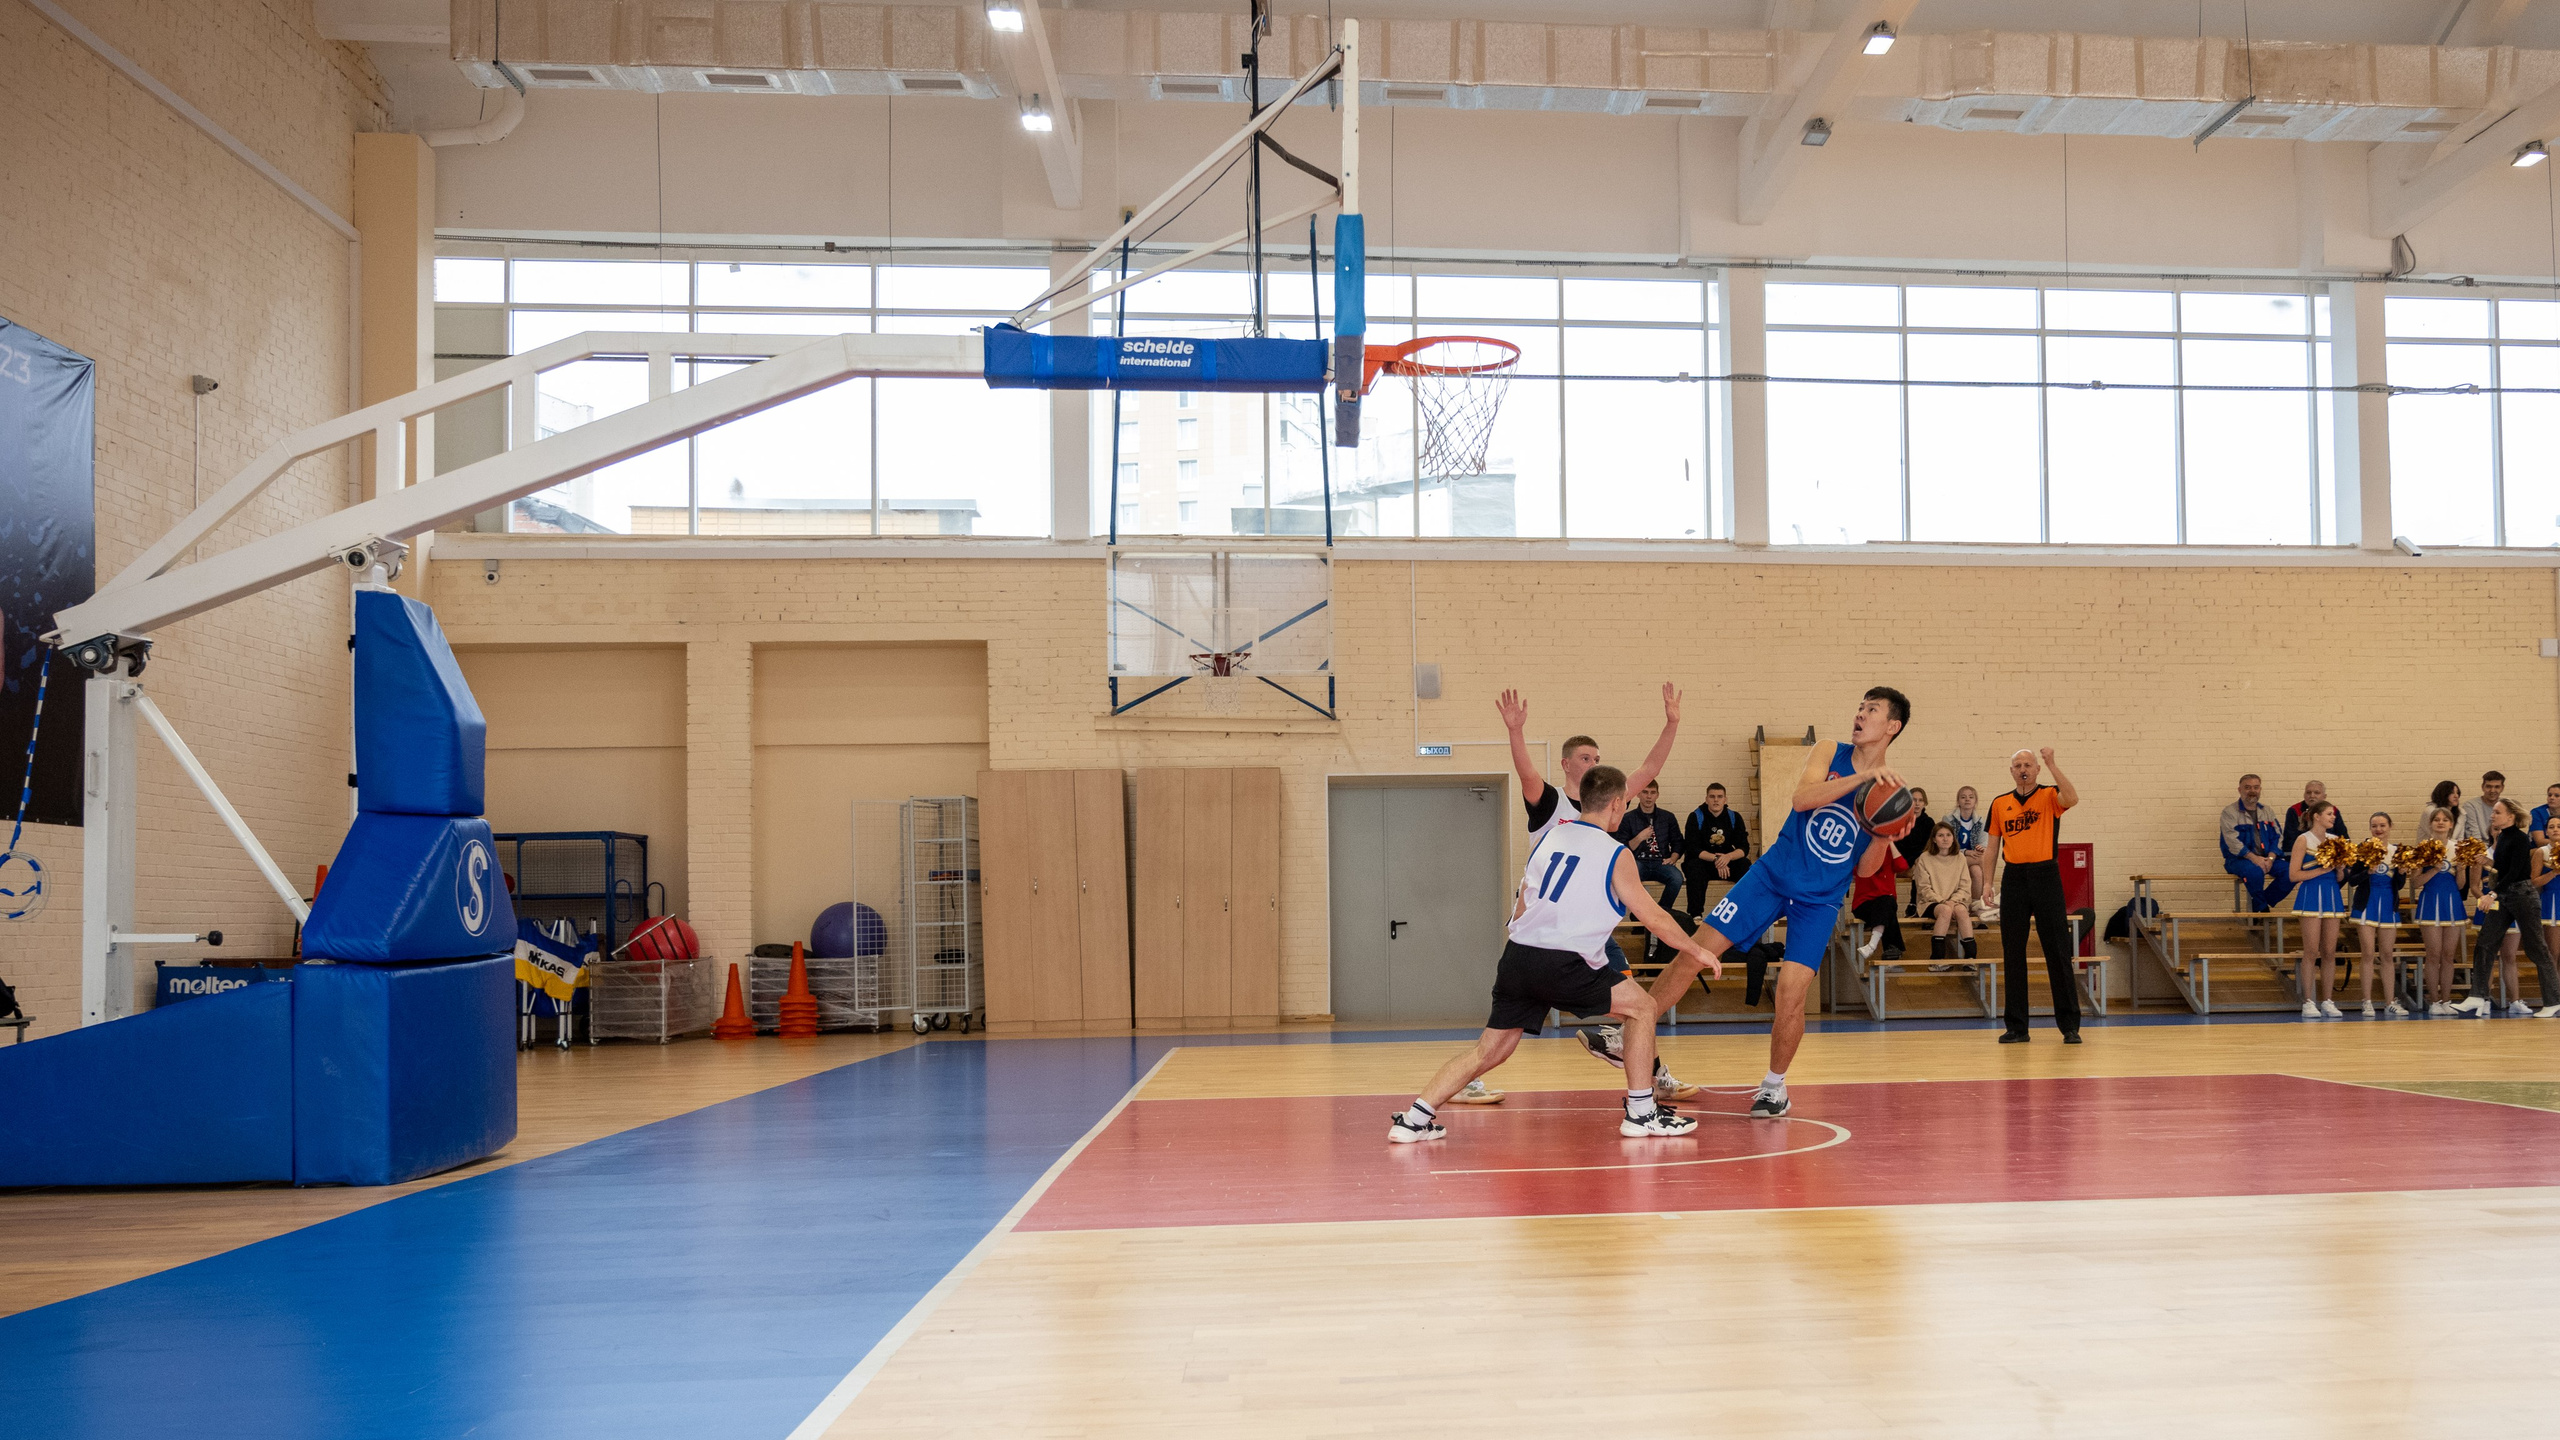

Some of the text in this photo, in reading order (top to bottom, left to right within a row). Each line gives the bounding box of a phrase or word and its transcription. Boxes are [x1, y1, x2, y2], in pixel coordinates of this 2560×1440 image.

[1123, 339, 1194, 355] schelde
[0, 343, 31, 385] 23
[1120, 355, 1191, 368] international
[1420, 747, 1449, 755] ВЫХОД
[1819, 817, 1846, 847] 88
[1538, 851, 1580, 903] 11
[1711, 897, 1738, 924] 88
